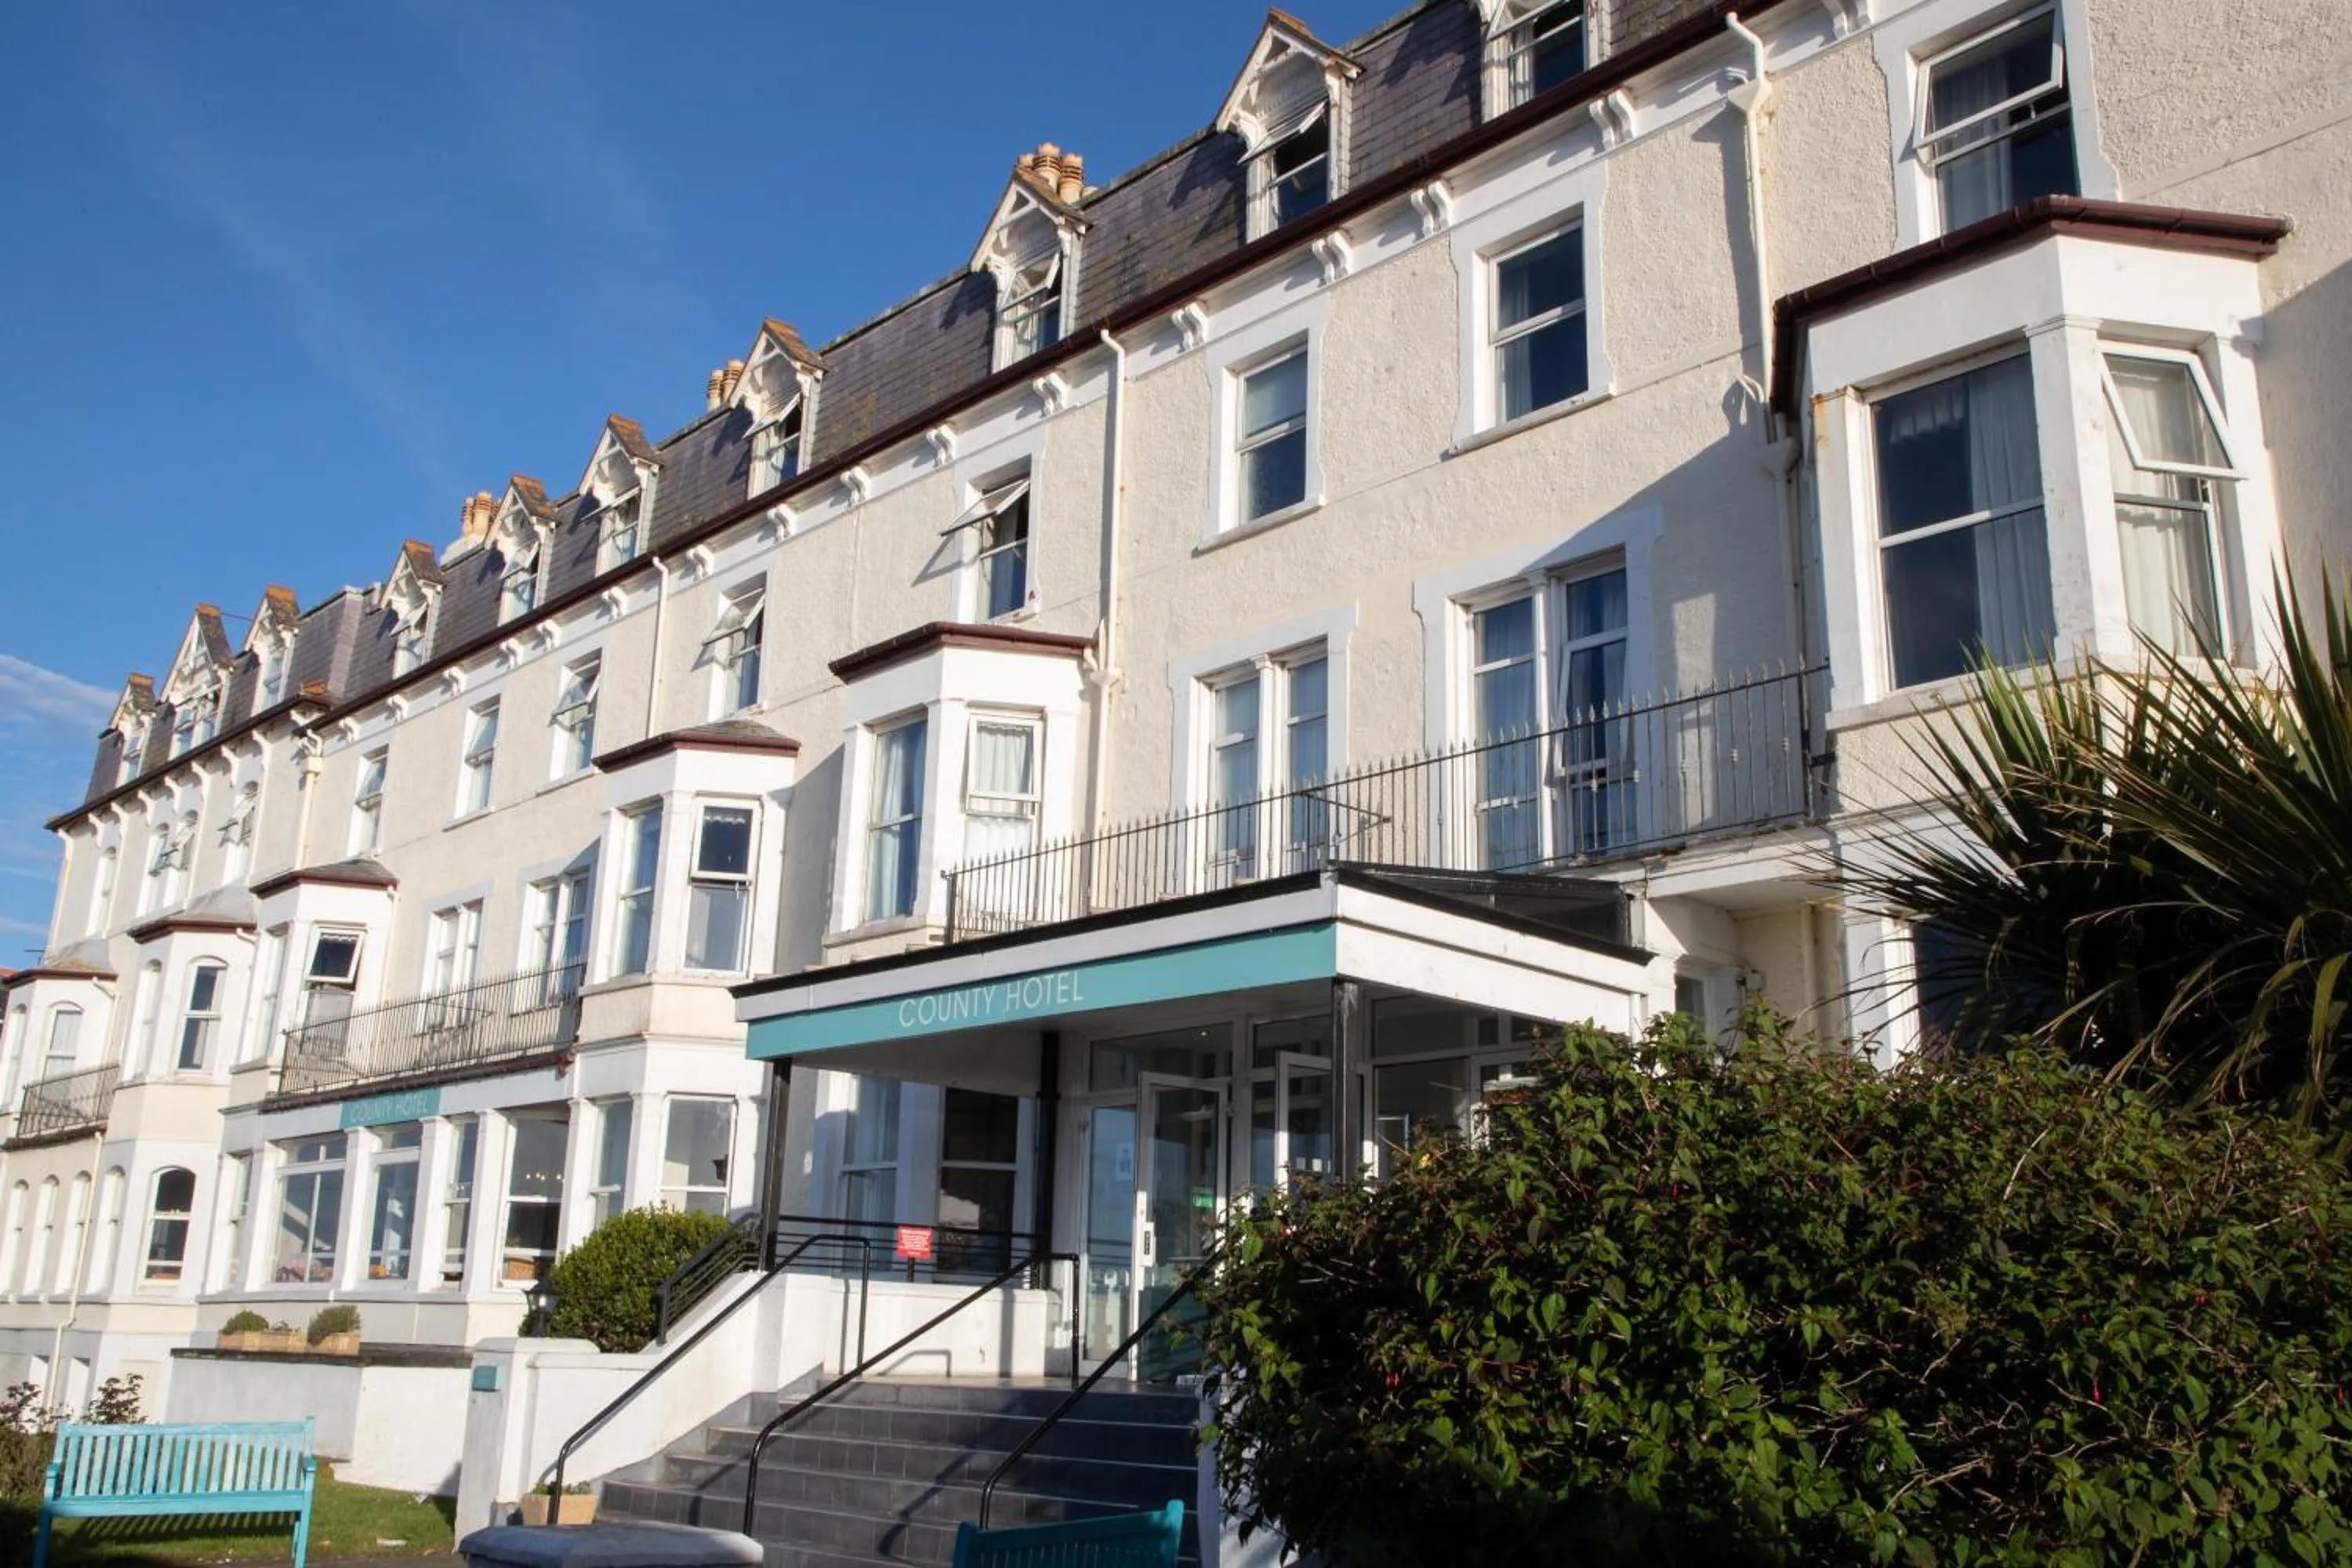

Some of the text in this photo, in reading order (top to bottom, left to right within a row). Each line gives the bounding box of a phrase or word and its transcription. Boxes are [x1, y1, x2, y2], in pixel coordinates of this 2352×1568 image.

[898, 971, 1083, 1027] COUNTY HOTEL
[350, 1093, 427, 1123] COUNTY HOTEL
